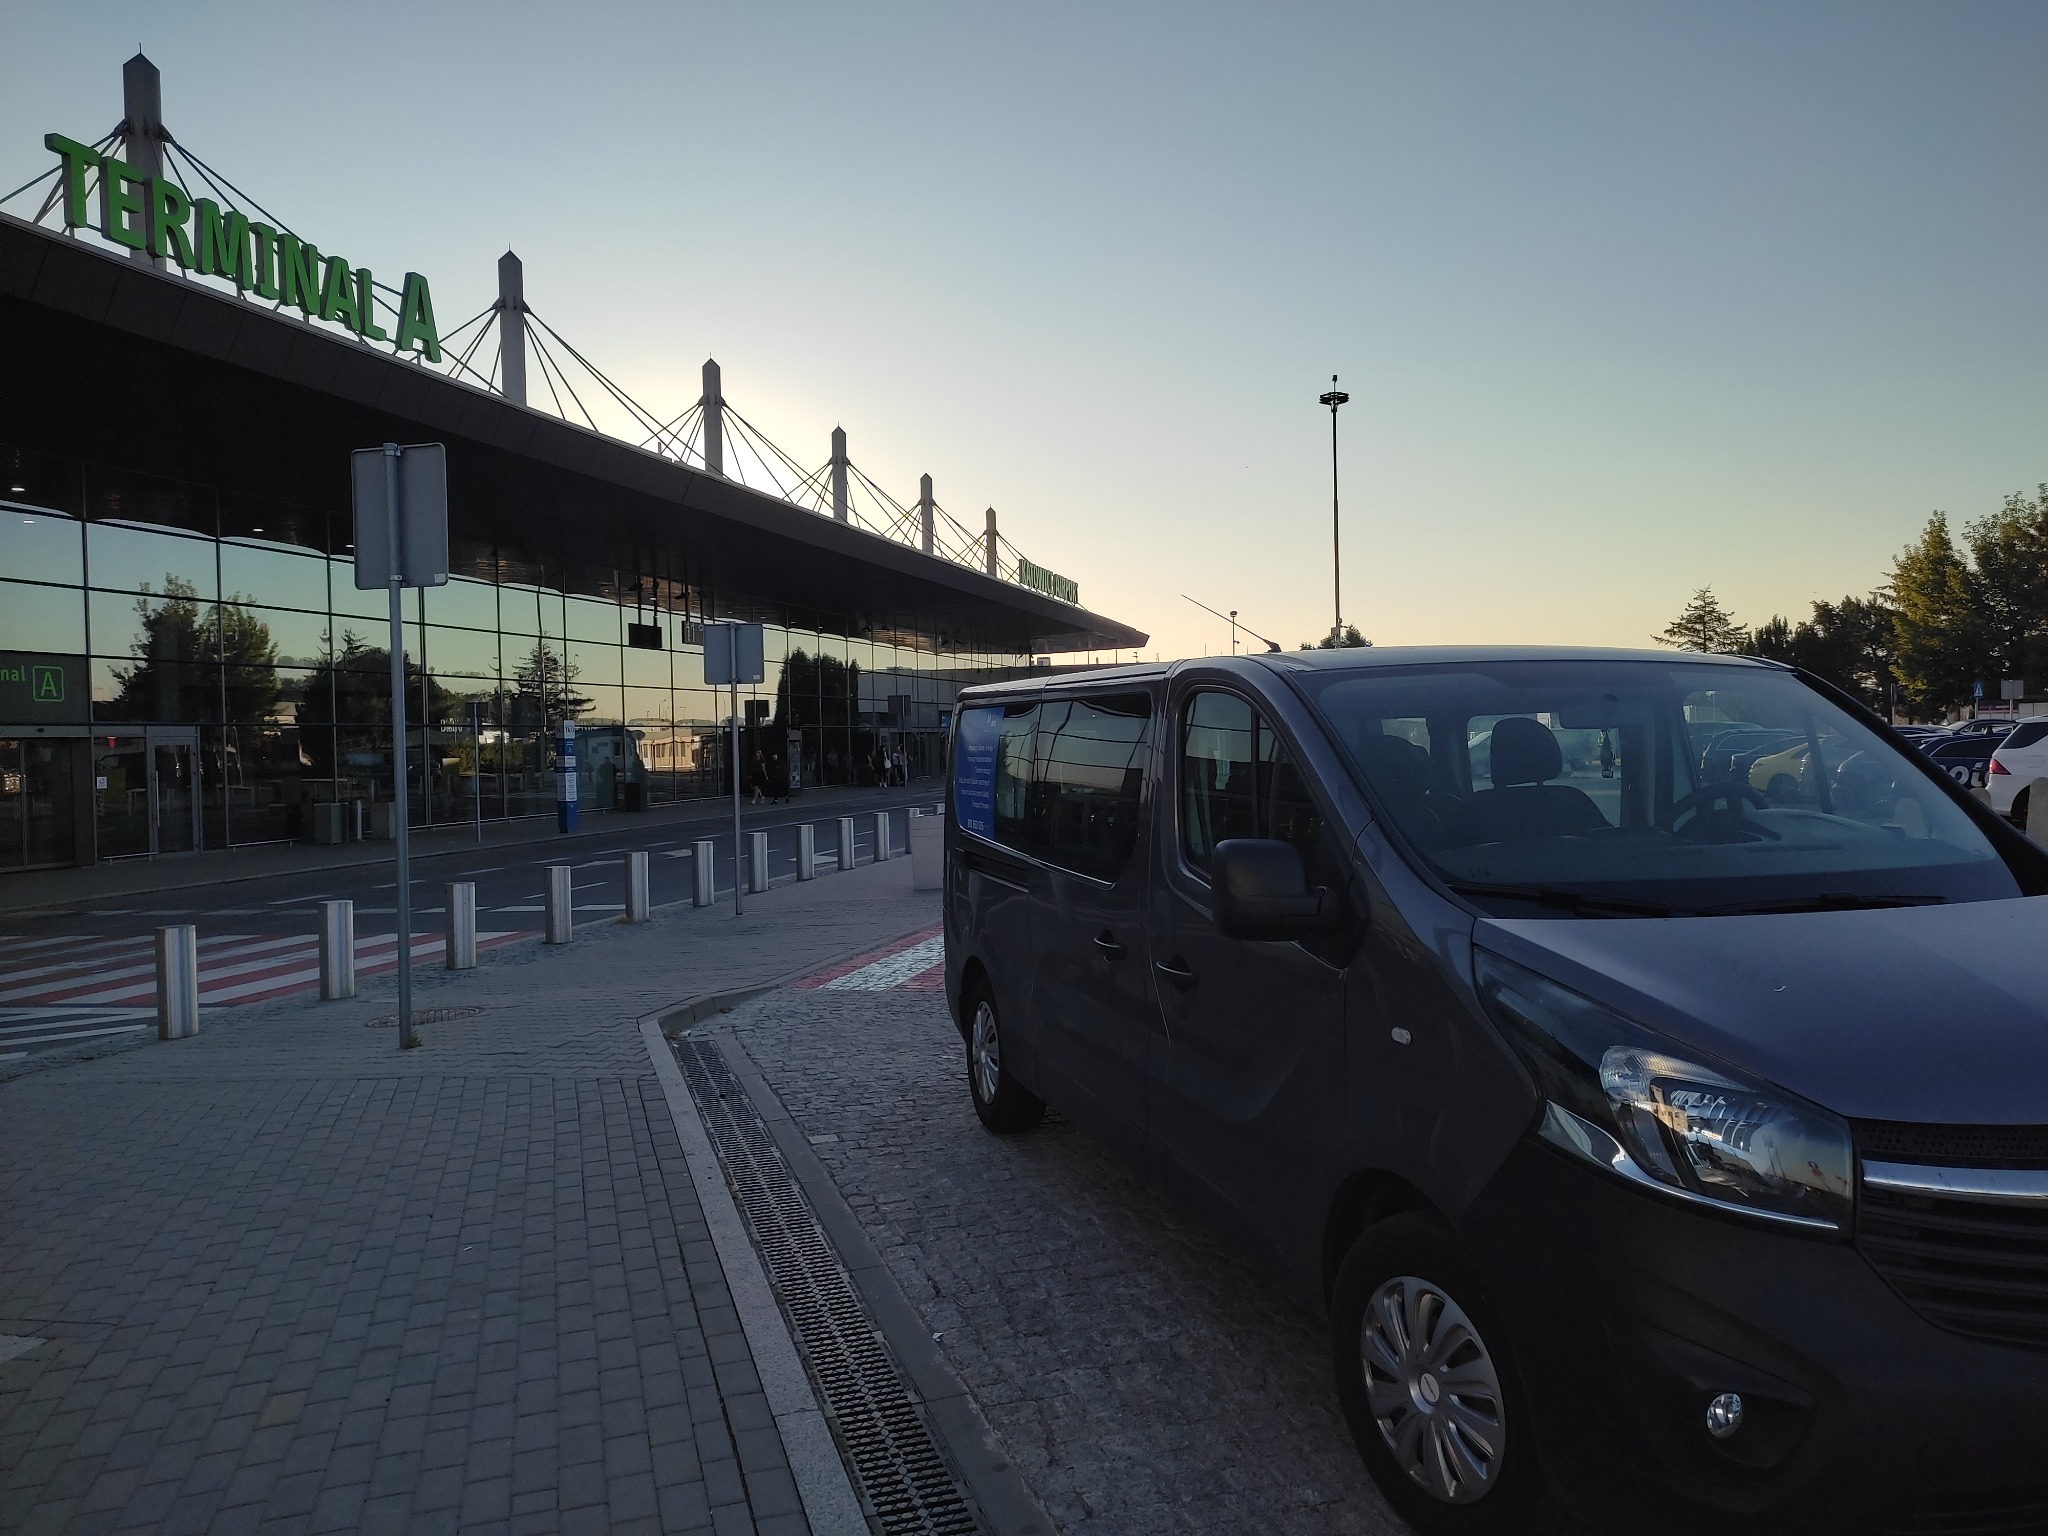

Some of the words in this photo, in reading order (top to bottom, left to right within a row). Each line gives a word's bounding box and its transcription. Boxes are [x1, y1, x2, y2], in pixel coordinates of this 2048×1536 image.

[44, 133, 386, 341] TERMINAL
[395, 271, 442, 363] A
[40, 671, 57, 697] A
